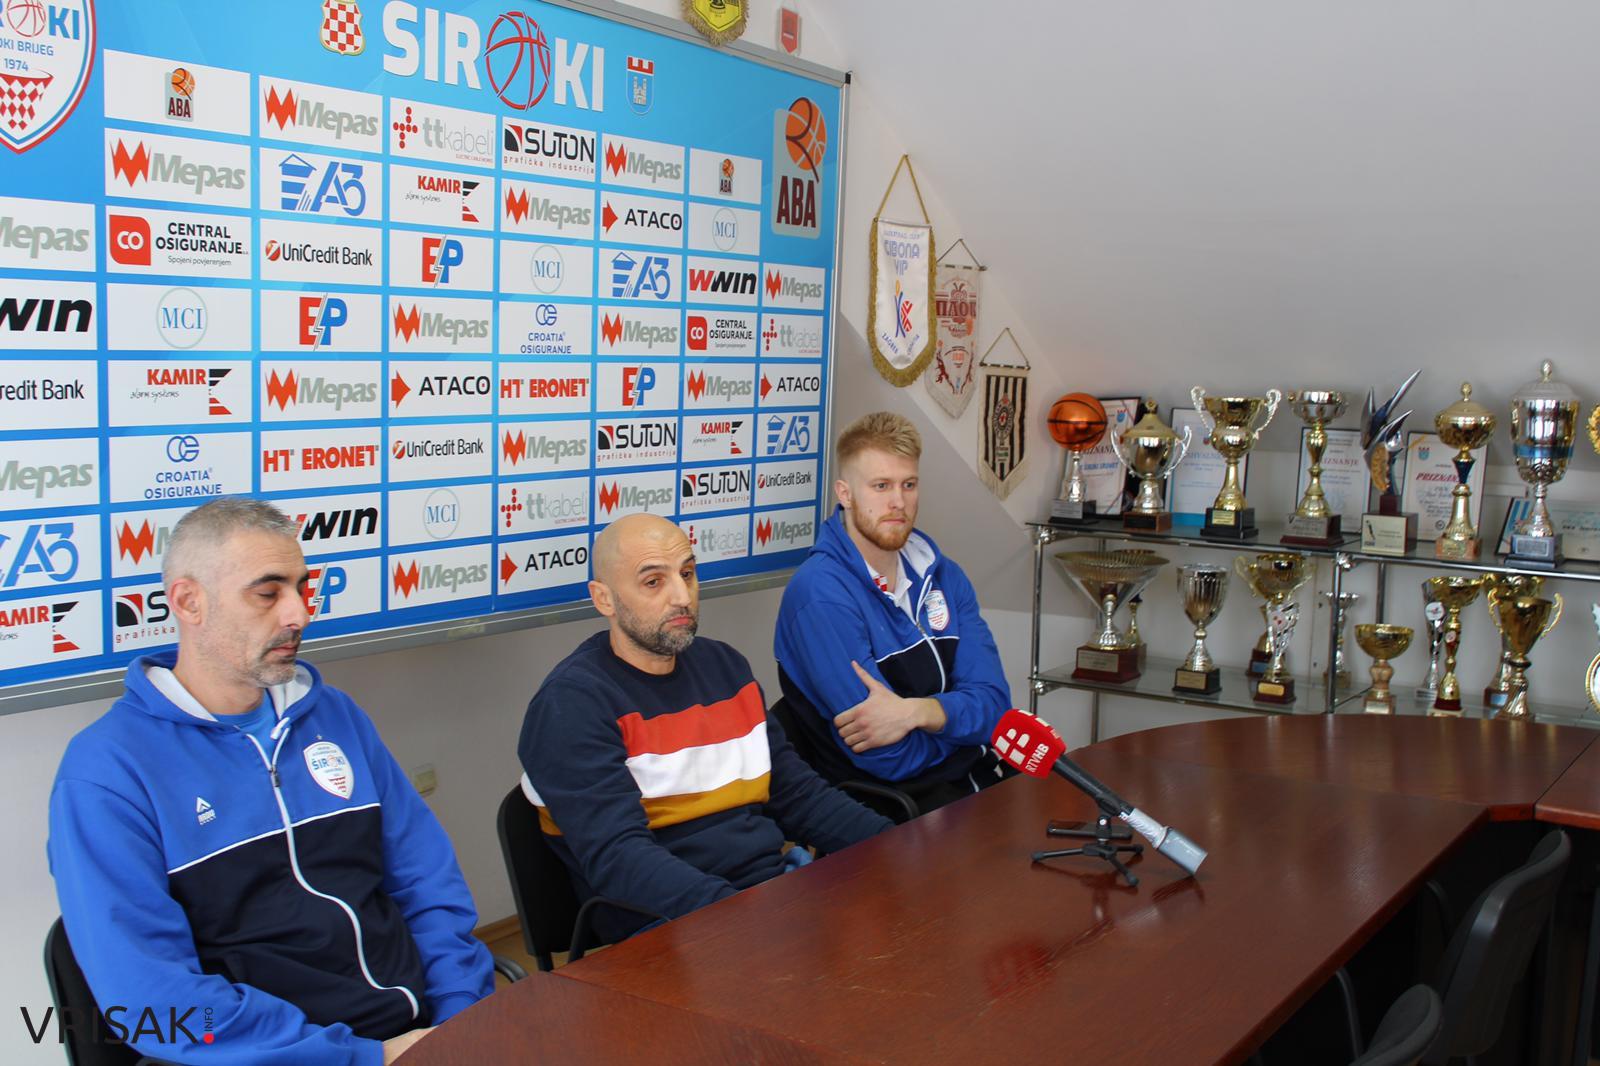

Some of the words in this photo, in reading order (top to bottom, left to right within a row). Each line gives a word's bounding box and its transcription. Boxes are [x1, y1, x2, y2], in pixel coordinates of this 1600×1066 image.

[17, 40, 54, 56] BRIJEG
[4, 58, 29, 72] 1974
[168, 97, 191, 118] ABA
[298, 99, 379, 140] Mepas
[524, 127, 595, 163] SUTON
[151, 152, 246, 195] Mepas
[627, 151, 682, 183] Mepas
[417, 175, 461, 194] KAMIR
[719, 178, 732, 194] ABA
[776, 176, 816, 228] ABA
[529, 197, 591, 230] Mepas
[624, 208, 682, 231] ATACO
[168, 222, 231, 239] CENTRAL
[714, 220, 736, 238] MCI
[155, 236, 243, 255] OSIGURANJE
[282, 244, 340, 264] UniCredit
[342, 246, 373, 266] Bank
[533, 259, 561, 279] MCI
[781, 276, 822, 303] Mepas
[161, 307, 204, 330] MCI
[421, 312, 489, 345] Mepas
[715, 319, 747, 330] CENTRAL
[623, 320, 677, 349] Mepas
[709, 329, 753, 341] OSIGURANJE
[520, 344, 571, 354] OSIGURANJE
[147, 369, 206, 386] KAMIR
[418, 375, 491, 396] ATACO
[705, 375, 752, 402] Mepas
[776, 376, 820, 393] ATACO
[42, 379, 84, 400] Bank
[299, 377, 377, 411] Mepas
[615, 422, 677, 449] SUTON
[701, 421, 731, 434] KAMIR
[406, 439, 455, 459] UniCredit
[457, 438, 484, 456] Bank
[526, 436, 587, 464] Mepas
[697, 470, 750, 496] SUTON
[765, 473, 795, 488] UniCredit
[795, 471, 812, 485] Bank
[144, 484, 222, 500] OSIGURANJE
[620, 486, 673, 512] Mepas
[426, 504, 457, 524] MCI
[771, 521, 813, 544] Mepas
[524, 546, 588, 573] ATACO
[420, 563, 489, 593] Mepas
[1025, 743, 1049, 773] RTVHB
